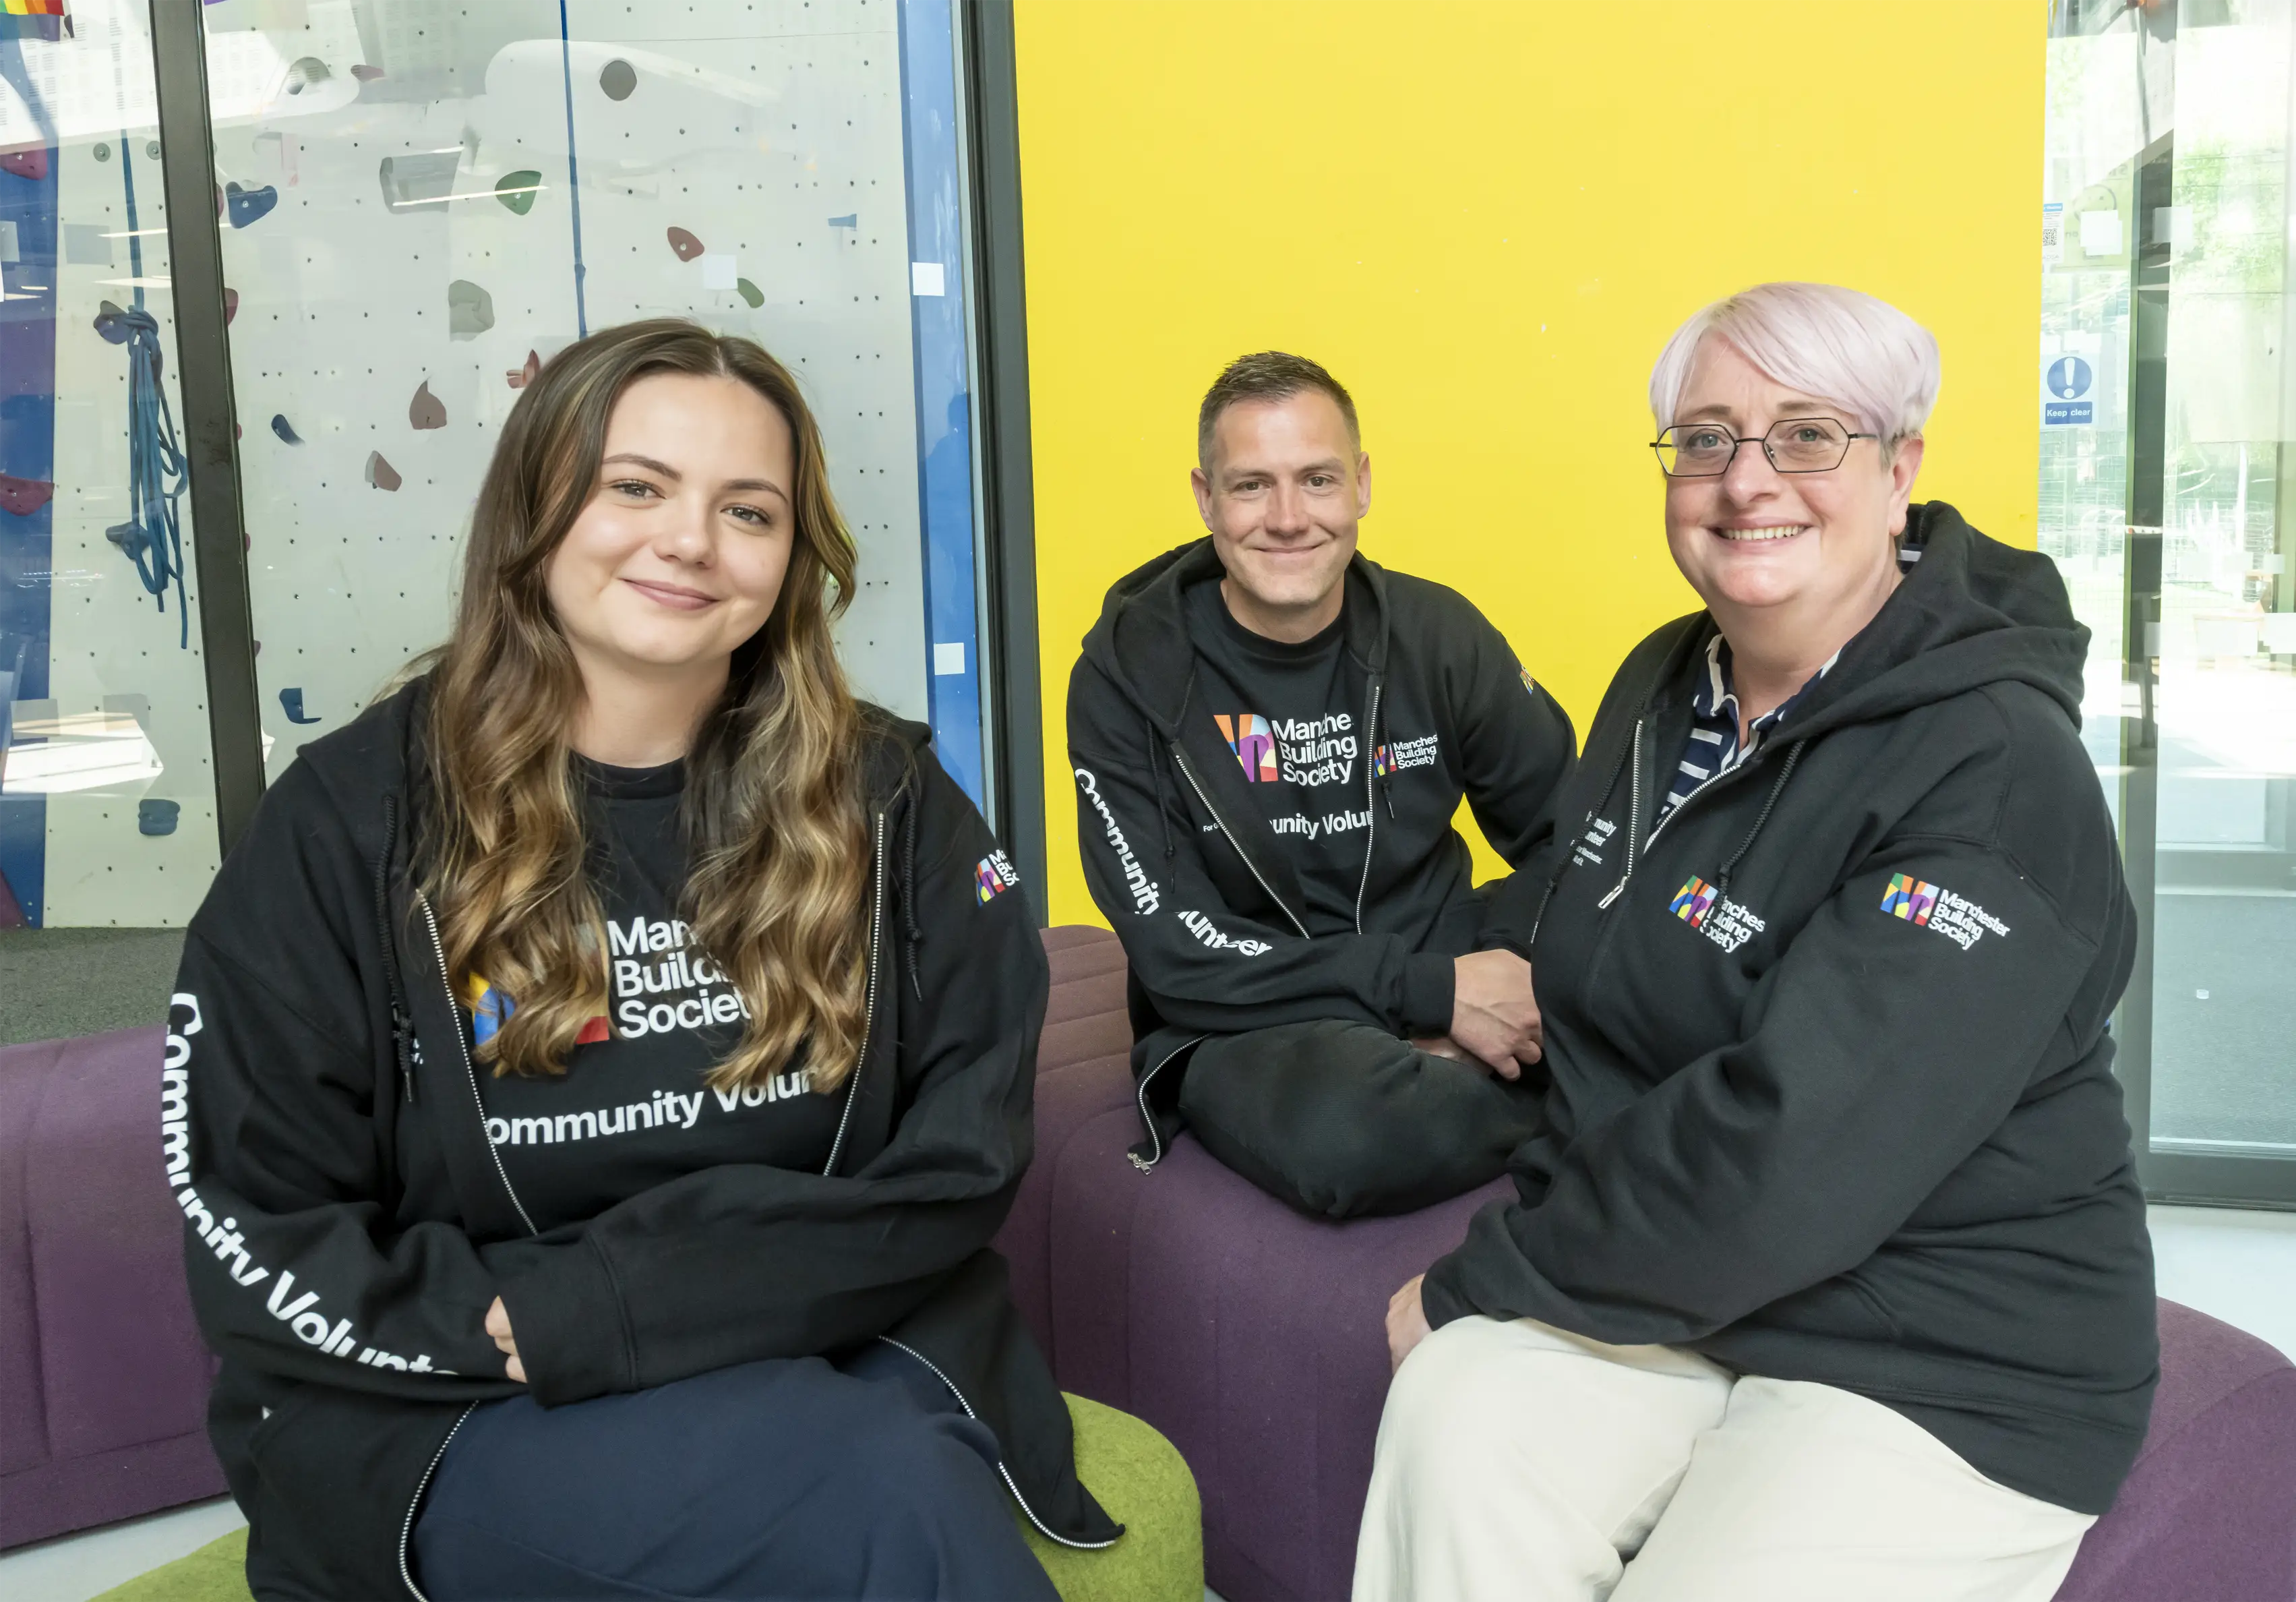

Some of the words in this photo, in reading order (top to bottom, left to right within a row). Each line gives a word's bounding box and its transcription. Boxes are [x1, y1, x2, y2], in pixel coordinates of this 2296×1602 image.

[2047, 409, 2067, 417] Keep
[1271, 713, 1353, 741] Manche
[1278, 736, 1358, 764] Building
[1393, 734, 1438, 751] Manches
[1395, 745, 1437, 761] Building
[1282, 759, 1352, 786] Society
[1397, 755, 1435, 769] Society
[1269, 813, 1319, 840] unity
[1933, 902, 1985, 941] Building
[1938, 889, 2011, 937] Manchester
[1928, 916, 1976, 951] Society
[486, 1090, 704, 1145] ommunity
